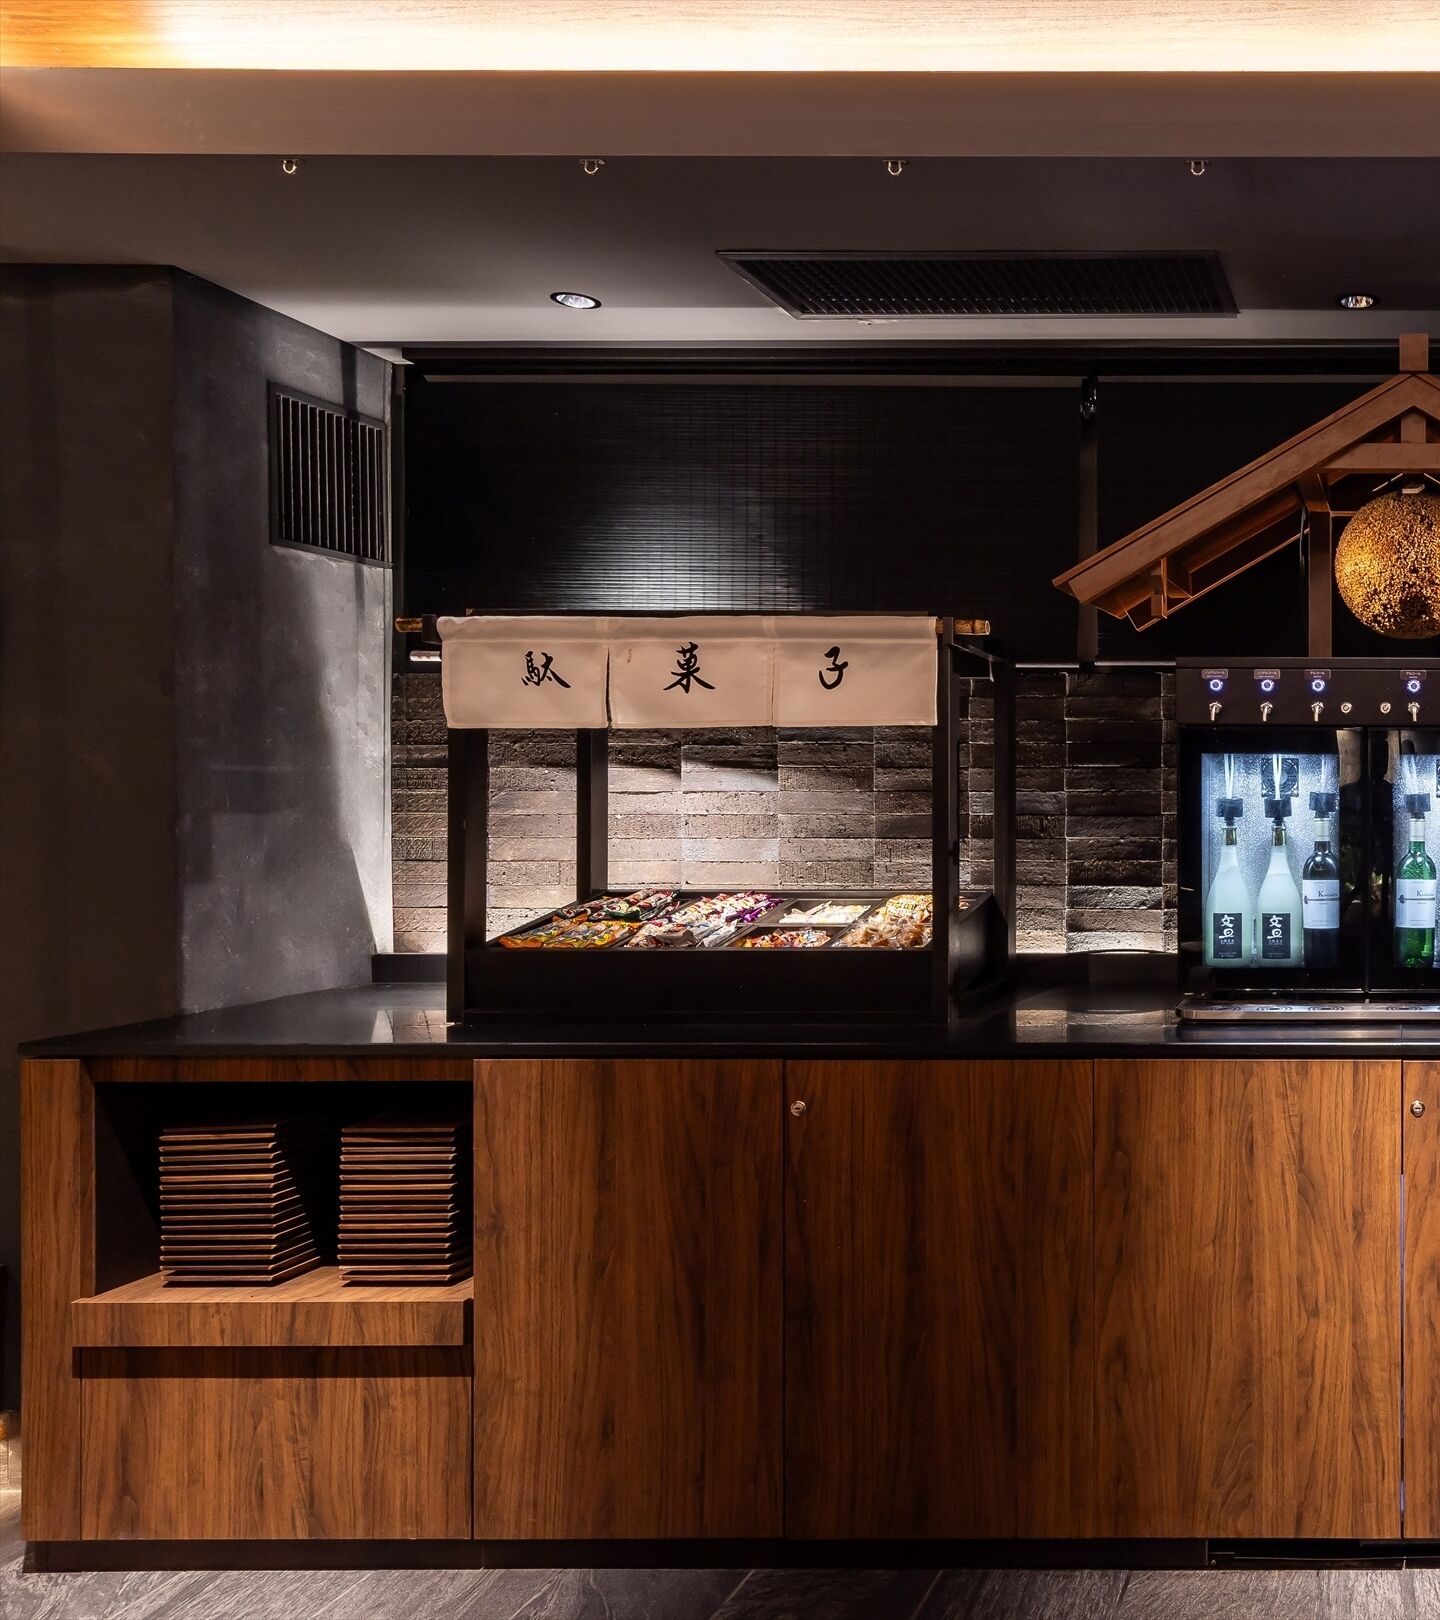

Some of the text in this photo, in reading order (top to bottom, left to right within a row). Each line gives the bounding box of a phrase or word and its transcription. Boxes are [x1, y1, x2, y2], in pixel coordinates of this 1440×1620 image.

[521, 641, 848, 694] 駄菓子
[1218, 914, 1235, 939] 文旦
[1266, 914, 1283, 940] 文旦
